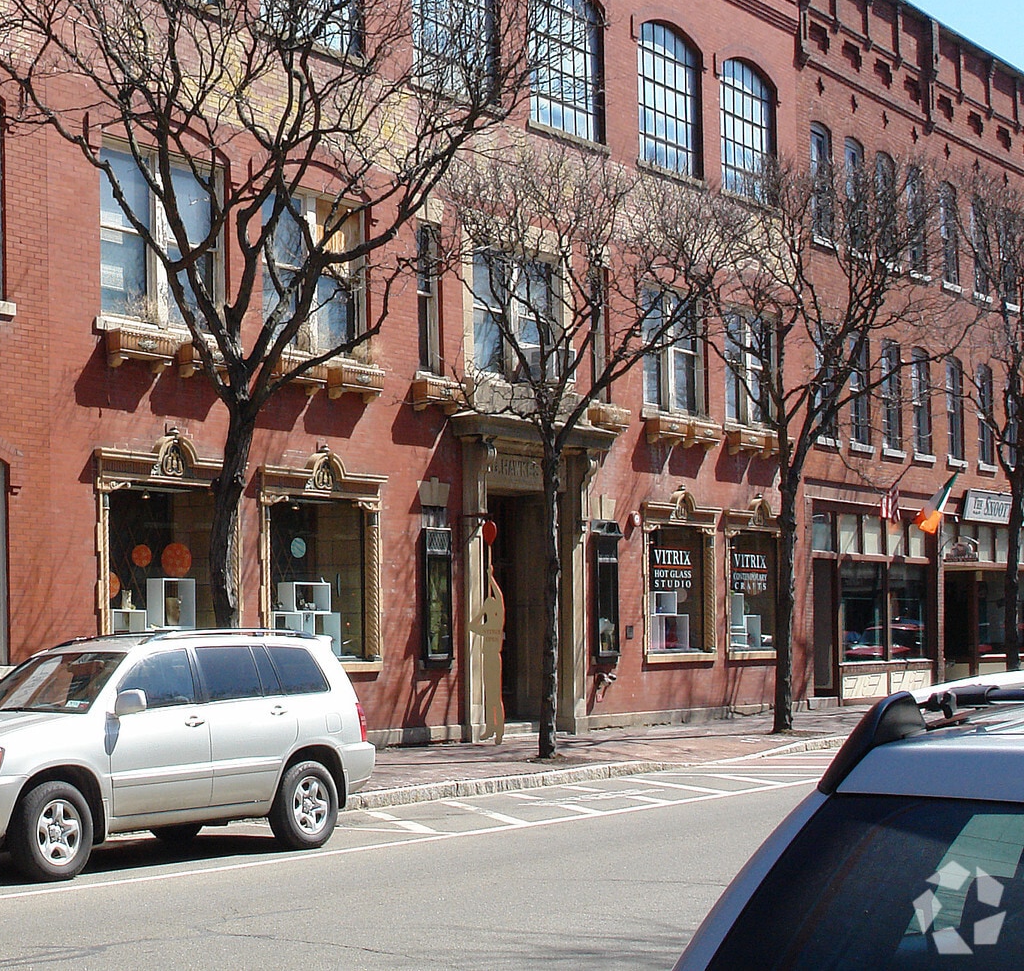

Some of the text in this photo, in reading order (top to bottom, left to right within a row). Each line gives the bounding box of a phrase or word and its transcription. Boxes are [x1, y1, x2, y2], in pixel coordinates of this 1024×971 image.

[984, 496, 1011, 518] SNOOT
[654, 549, 691, 565] VITRIX
[733, 553, 767, 569] VITRIX
[654, 569, 691, 579] HOT GLASS
[654, 579, 691, 588] STUDIO
[734, 581, 767, 590] CRAFTS
